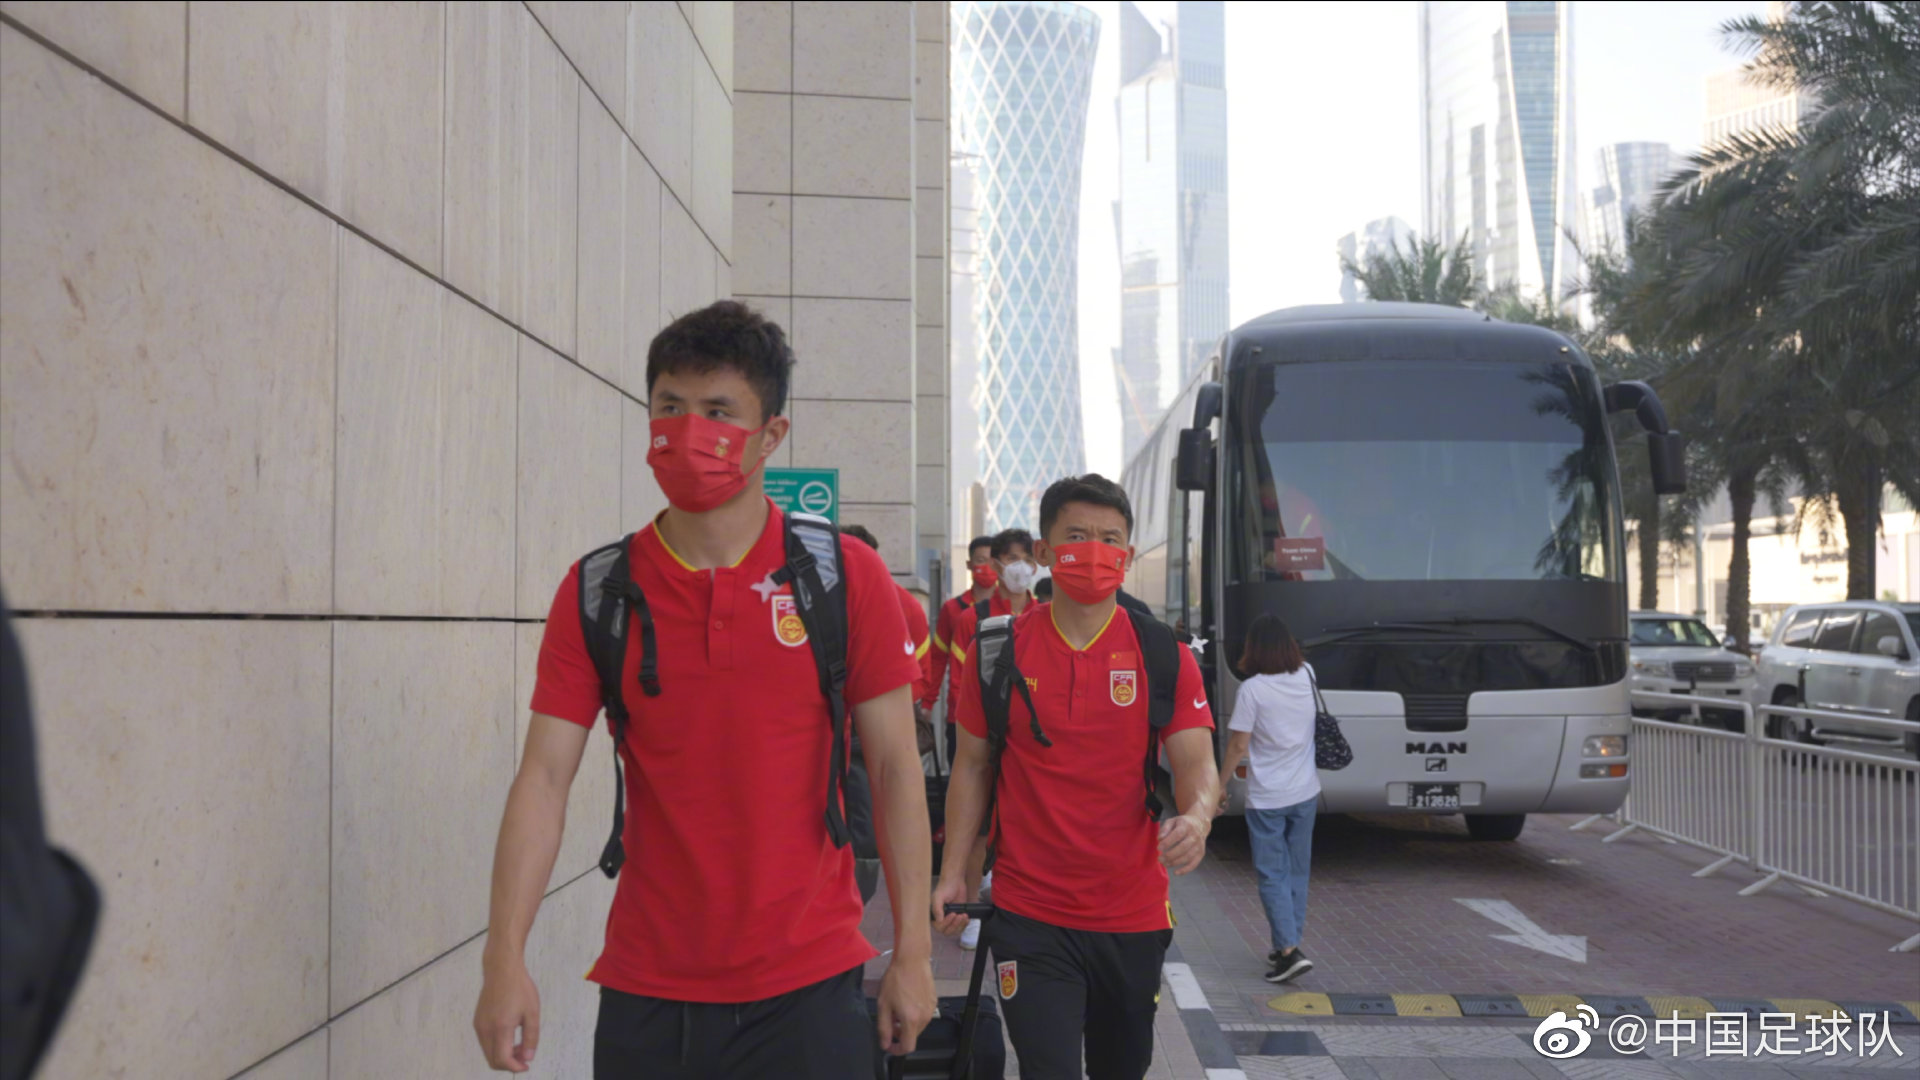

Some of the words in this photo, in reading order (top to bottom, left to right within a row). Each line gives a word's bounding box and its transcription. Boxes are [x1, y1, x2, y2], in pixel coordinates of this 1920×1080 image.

[653, 435, 669, 448] CFA
[1060, 554, 1076, 564] CFA
[1405, 742, 1467, 754] MAN
